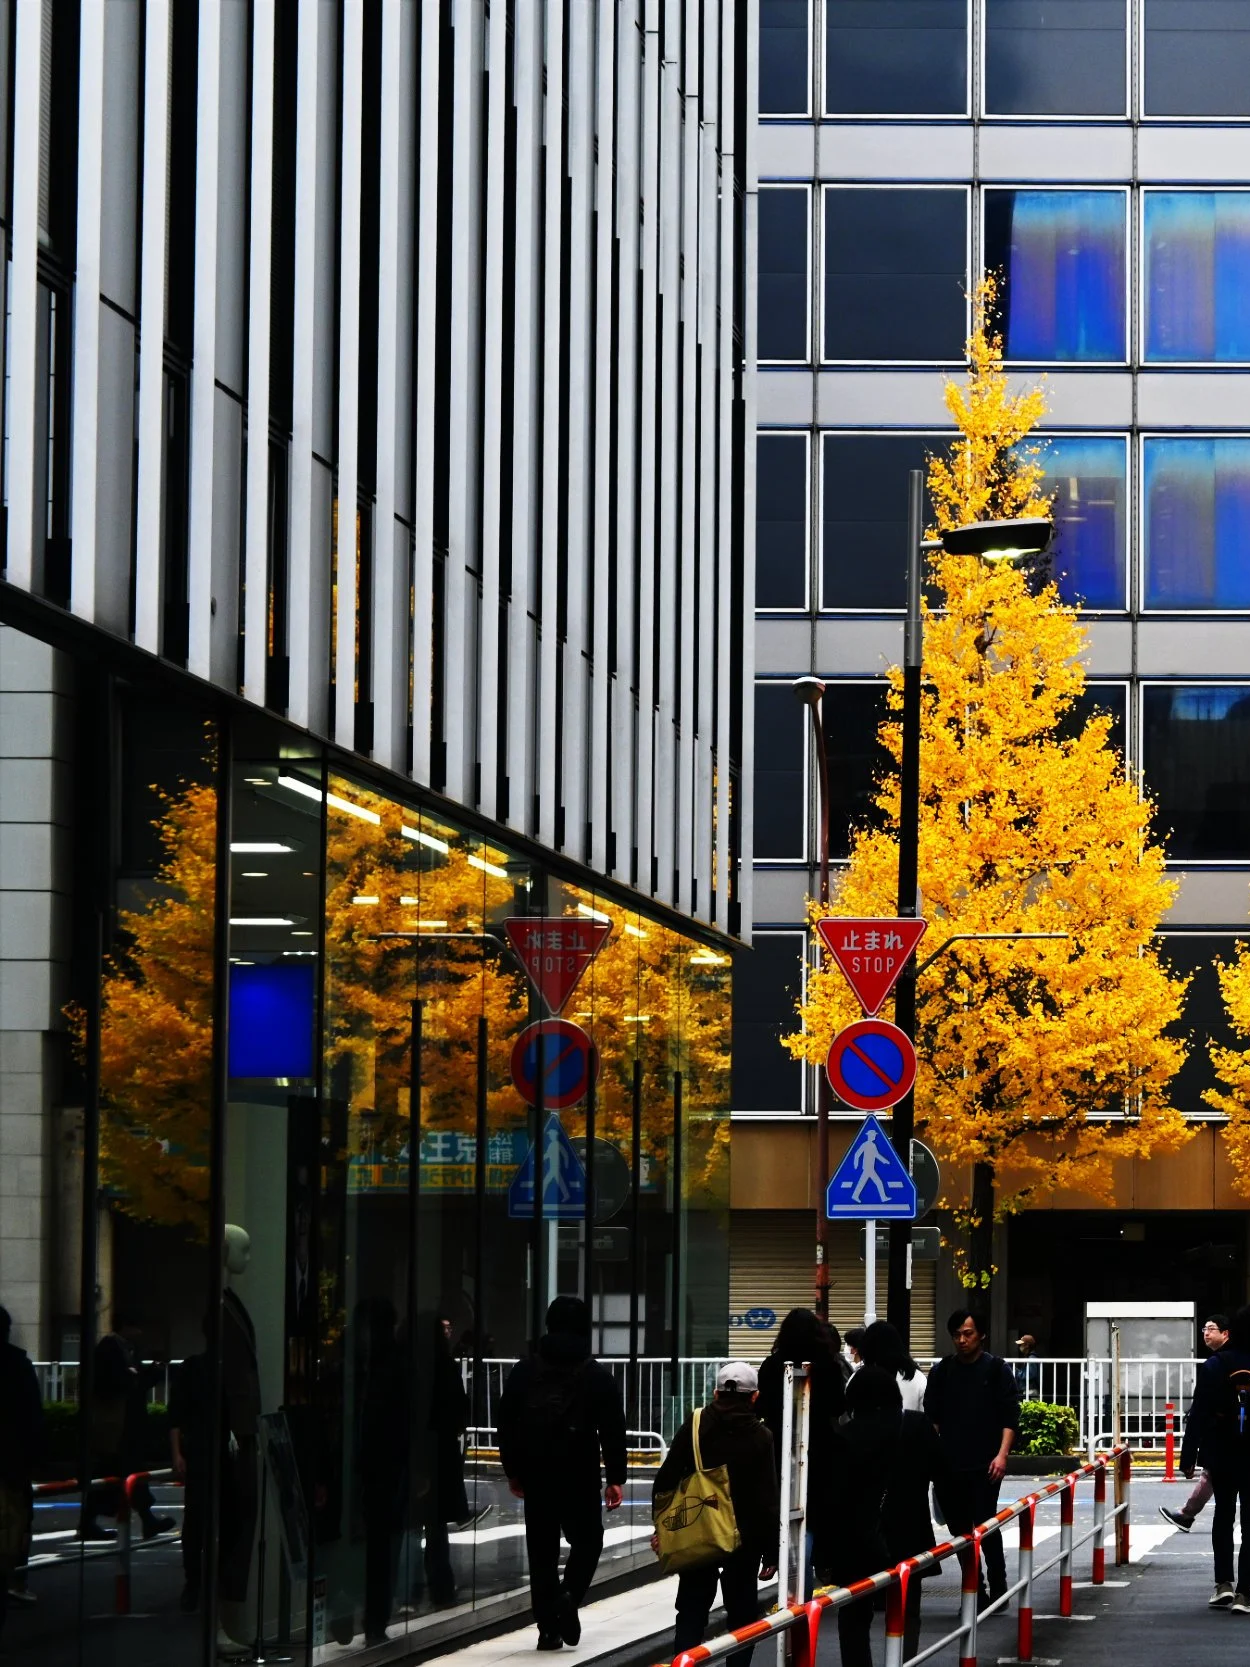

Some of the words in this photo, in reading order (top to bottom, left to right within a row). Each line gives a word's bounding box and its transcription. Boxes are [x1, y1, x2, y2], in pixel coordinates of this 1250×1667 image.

[841, 929, 904, 951] 止まれ
[852, 956, 895, 973] STOP
